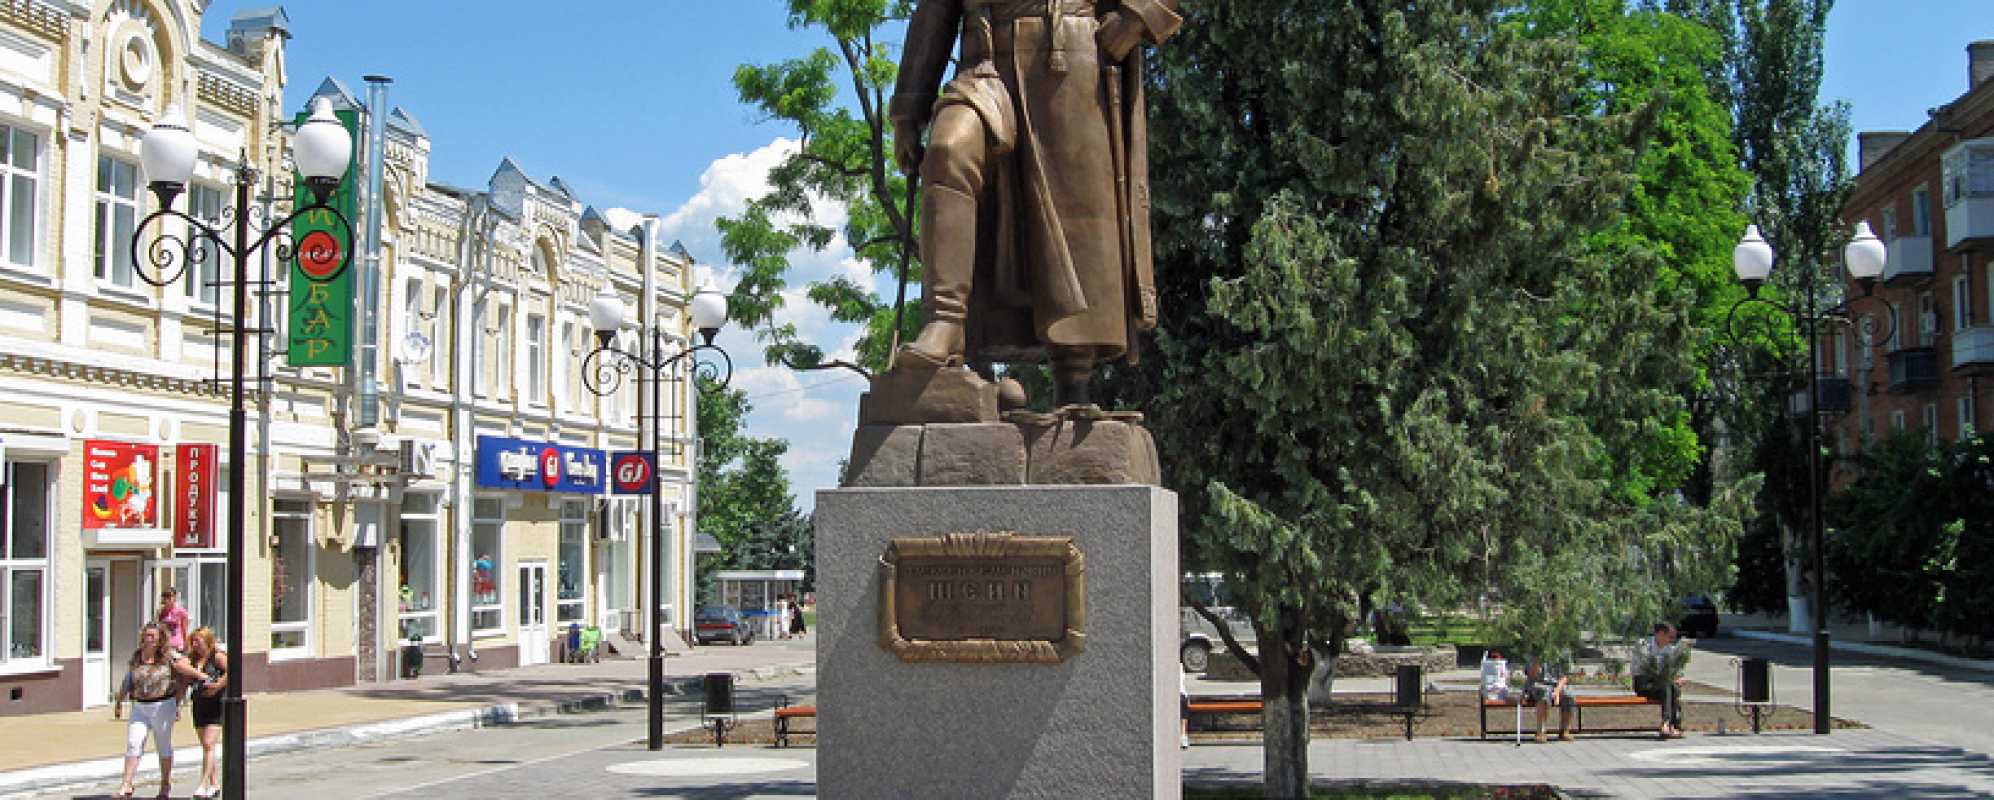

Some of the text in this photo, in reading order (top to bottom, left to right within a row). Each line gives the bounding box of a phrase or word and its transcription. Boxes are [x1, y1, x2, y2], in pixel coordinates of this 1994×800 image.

[304, 283, 331, 360] БАР
[185, 447, 199, 543] ПРОДУКТЫ
[618, 463, 645, 483] GJ
